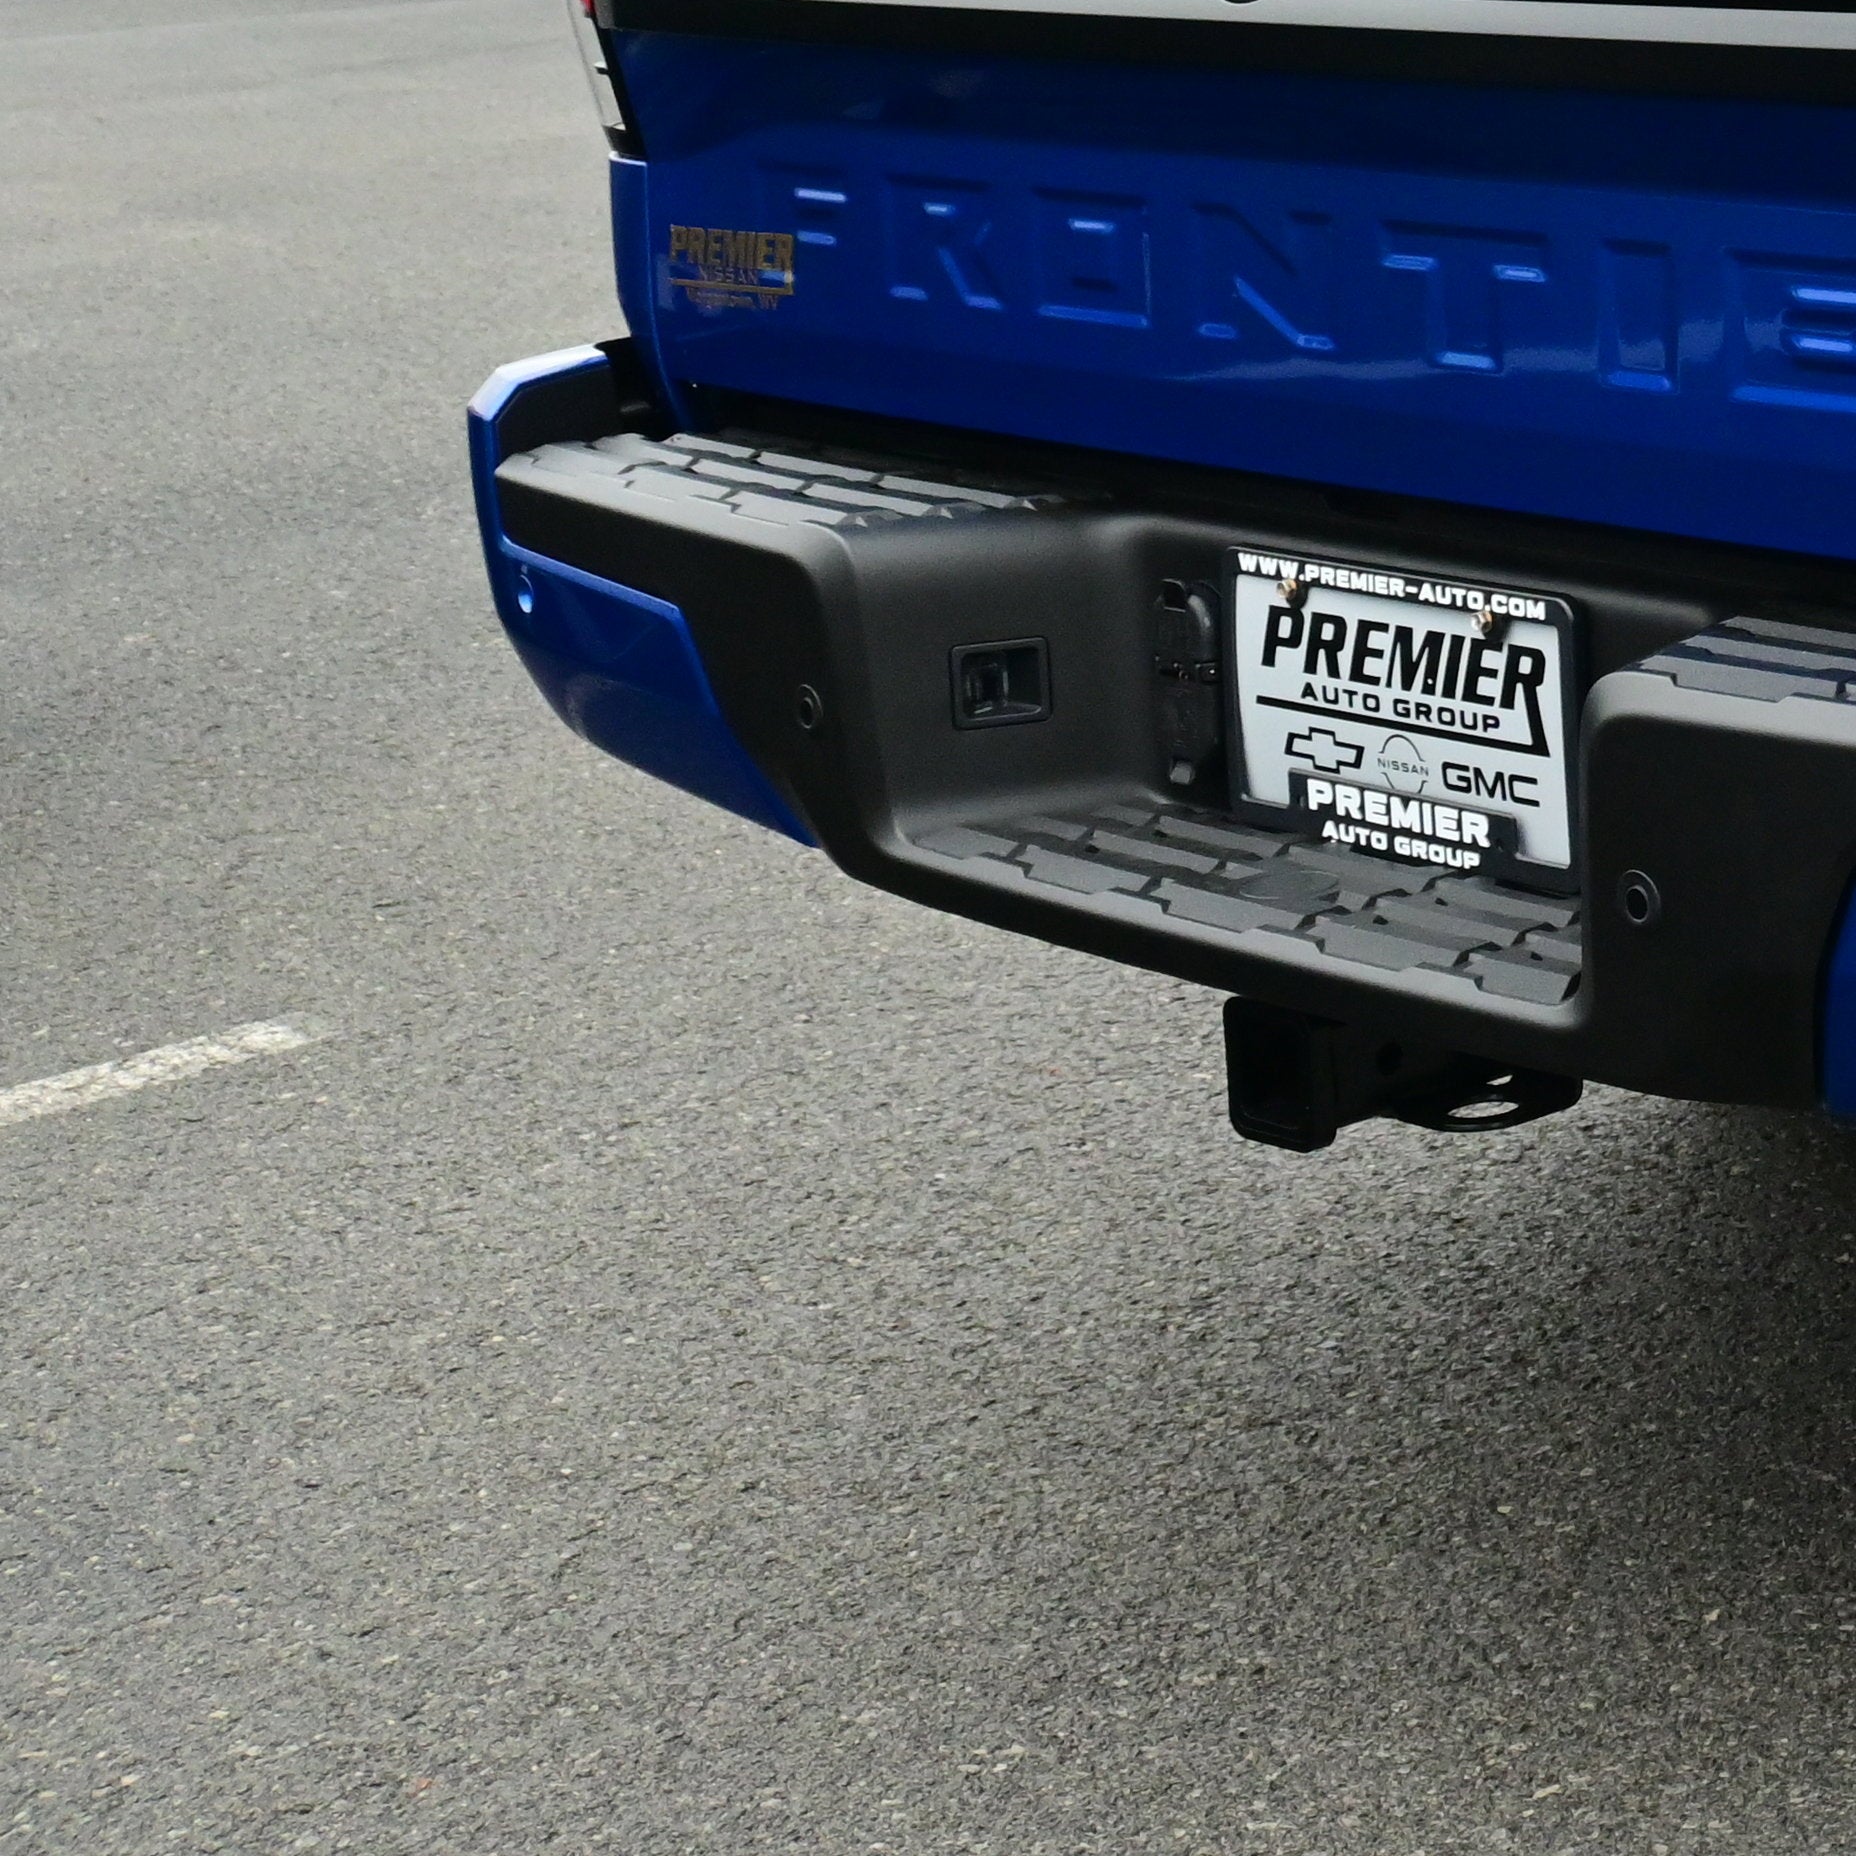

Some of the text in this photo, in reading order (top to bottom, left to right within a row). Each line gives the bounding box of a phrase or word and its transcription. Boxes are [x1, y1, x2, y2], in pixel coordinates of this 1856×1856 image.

[670, 224, 793, 271] PREMIER
[1238, 552, 1546, 621] WWW.PREMIER-AUTO.COM
[1261, 604, 1546, 711] PREMIER
[1301, 681, 1501, 734] AUTO GROUP
[1377, 756, 1430, 777] NISSAN
[1441, 761, 1541, 808] GMC
[1306, 778, 1491, 848] PREMIER
[1321, 820, 1481, 870] AUTO GROUP
